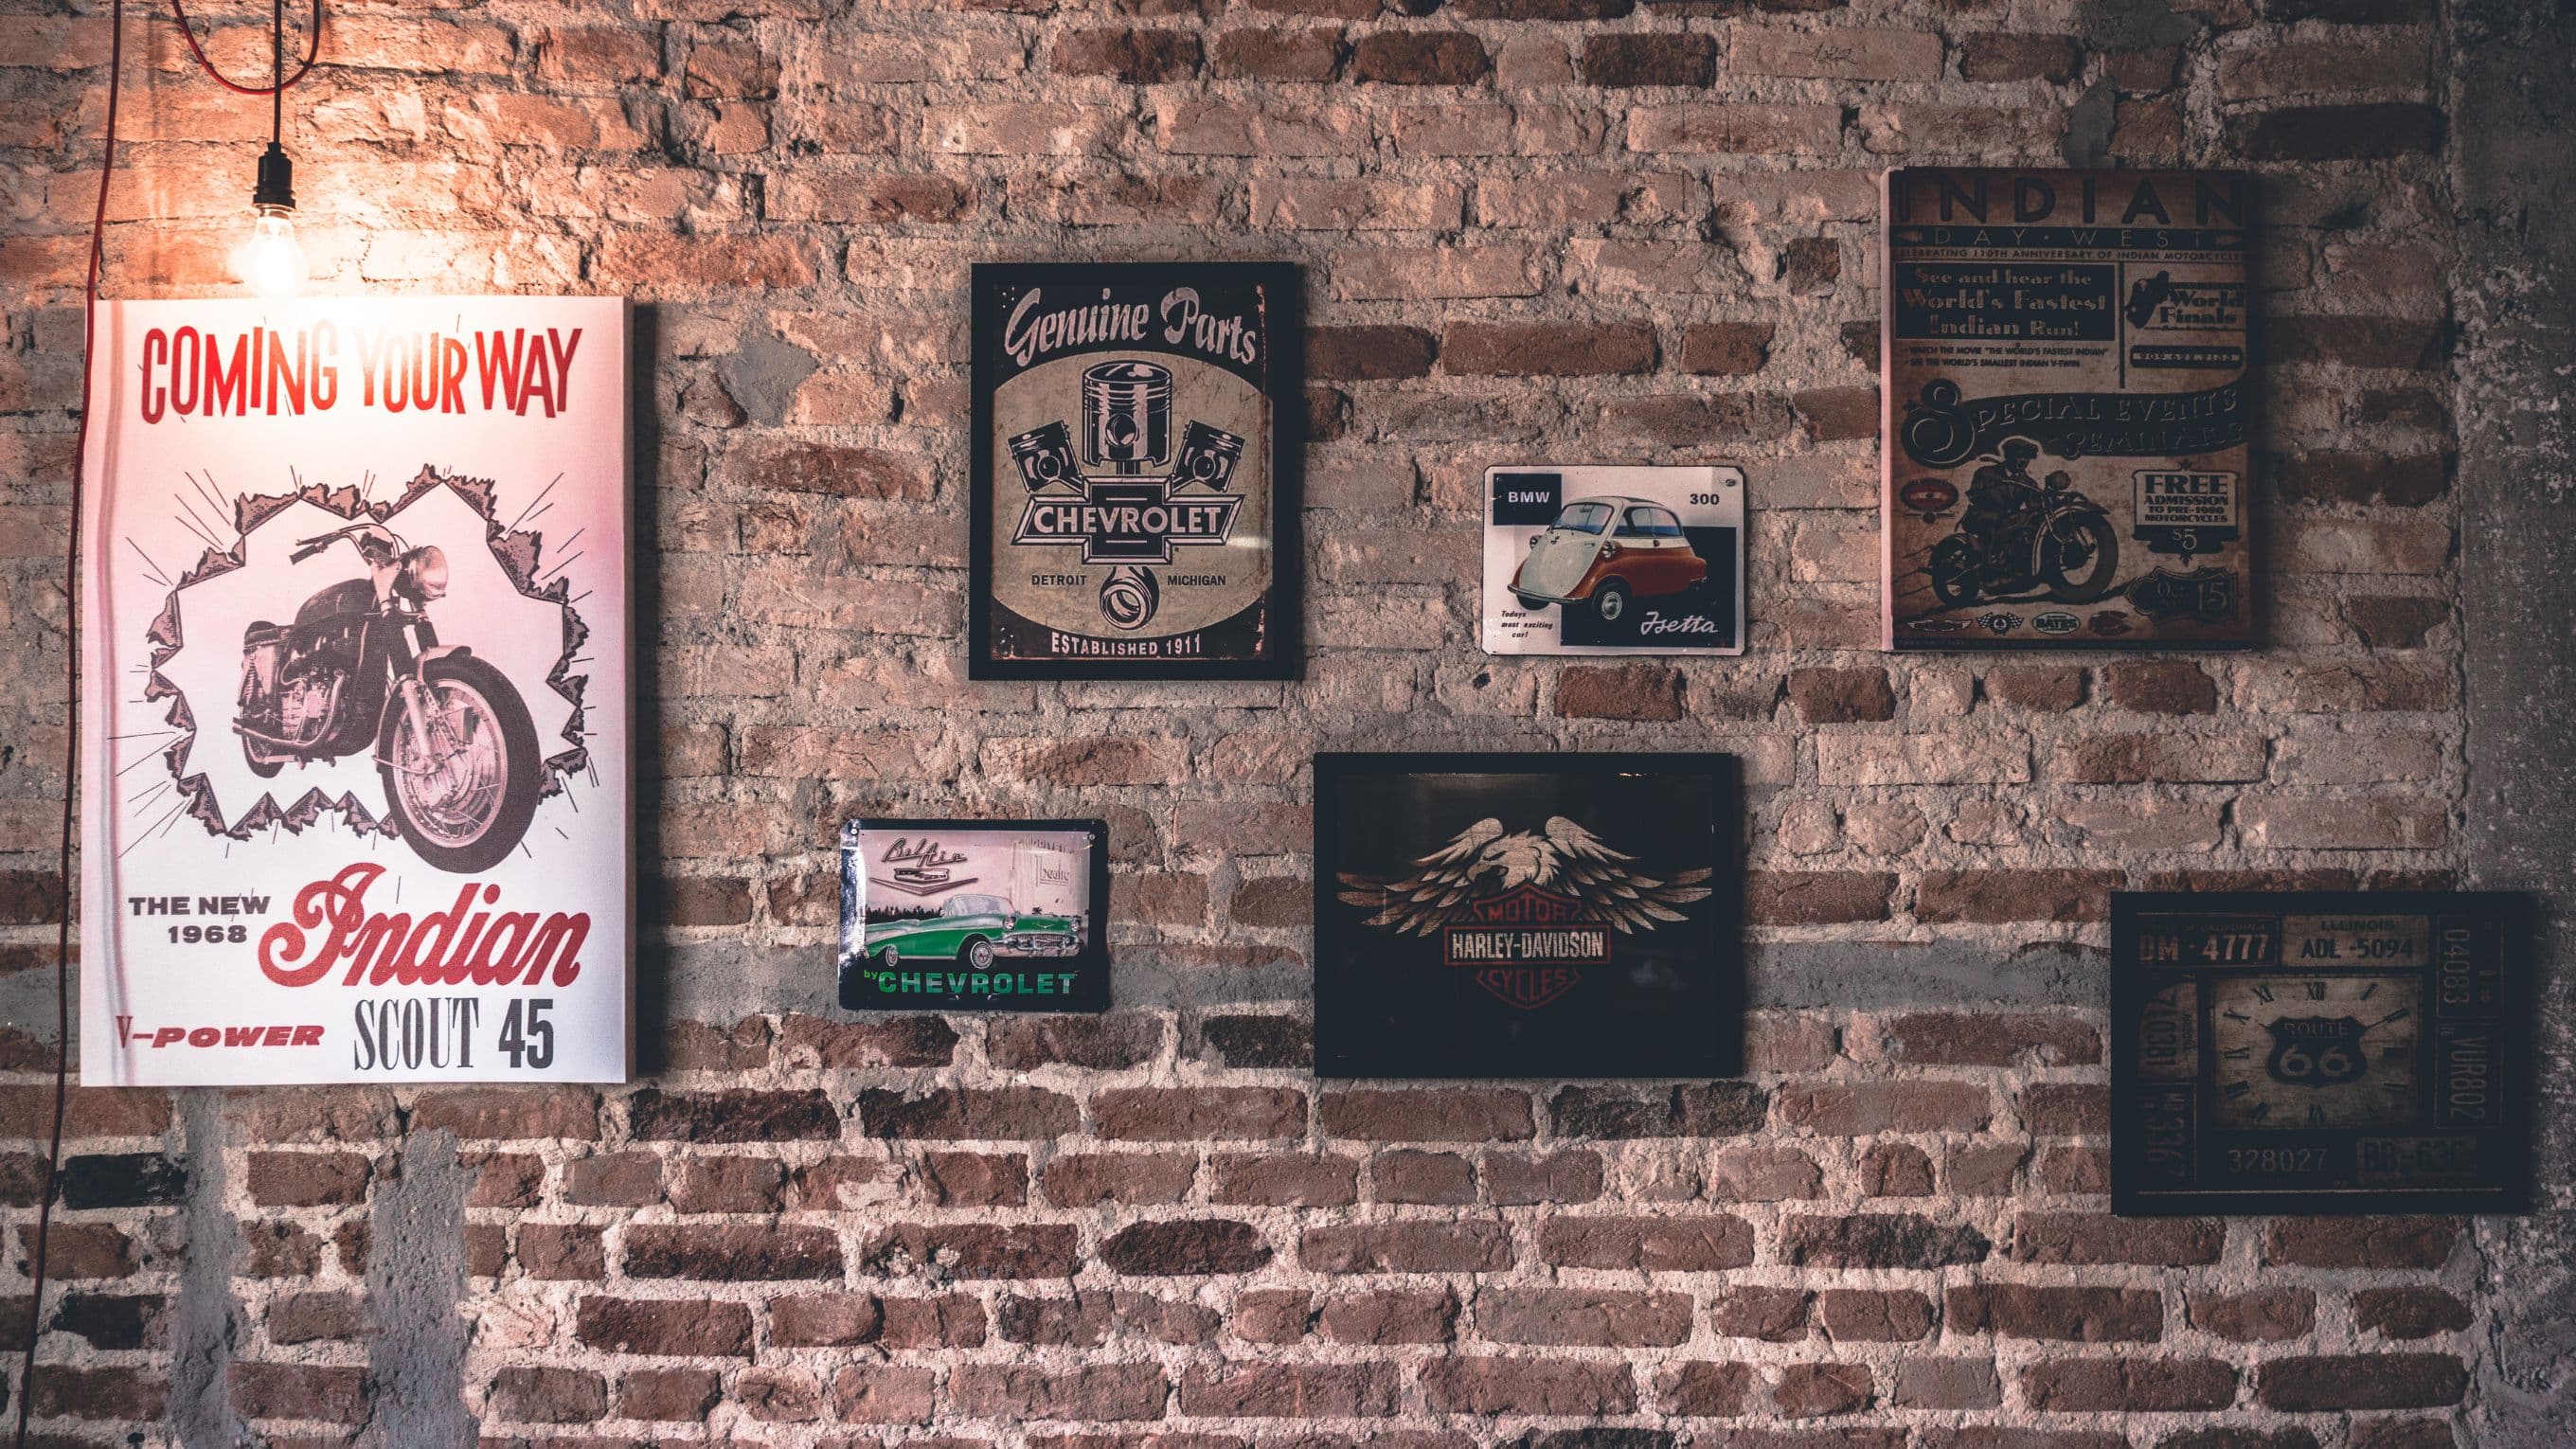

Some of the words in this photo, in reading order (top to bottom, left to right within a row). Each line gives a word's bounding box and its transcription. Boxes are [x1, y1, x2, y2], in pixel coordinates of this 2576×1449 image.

[1898, 174, 2244, 225] INDIAN
[1935, 227, 2031, 247] DAY
[2069, 229, 2204, 248] WEST
[2013, 249, 2093, 259] ANNIVERSARY
[2098, 250, 2113, 259] OF
[2118, 251, 2159, 259] INDIAN
[1914, 267, 1952, 283] See
[1959, 268, 1998, 284] and
[2005, 269, 2053, 284] hear
[1902, 288, 2004, 310] World's
[2014, 288, 2107, 311] Fastest
[1929, 313, 2020, 334] Indian
[2160, 307, 2237, 323] Finals
[1004, 287, 1150, 367] Genuine
[1160, 287, 1257, 365] Parts
[142, 319, 337, 424] COMING
[354, 331, 468, 415] YOUR
[476, 328, 583, 418] WAY
[2144, 474, 2228, 494] FREE
[1508, 491, 1550, 504] BMW
[1690, 492, 1720, 505] 300
[2144, 495, 2228, 506] ADMISSION
[1033, 507, 1222, 533] CHEVROLET
[2144, 514, 2228, 523] MOTORCYCLES
[1031, 575, 1087, 586] DETROIT
[1168, 575, 1226, 586] MICHIGAN
[1051, 632, 1158, 656] ESTABLISHED
[1166, 632, 1202, 655] 1911
[128, 896, 189, 916] THE
[198, 895, 271, 916] NEW
[1488, 892, 1568, 922] MOTOR
[168, 924, 247, 945] 1968
[258, 862, 592, 988] Indian
[2320, 920, 2396, 932] ILLINOIS
[1452, 932, 1604, 959] HARLEY-DAVIDSON
[864, 969, 878, 981] by
[879, 972, 1078, 994] CHEVROLET
[1487, 968, 1567, 1002] CYCLES
[116, 1015, 325, 1048] V-POWER
[354, 997, 479, 1071] SCOUT
[498, 998, 554, 1069] 45
[2283, 1021, 2350, 1037] ROUTE
[2279, 1043, 2354, 1077] 66
[2227, 1147, 2329, 1174] 328027
